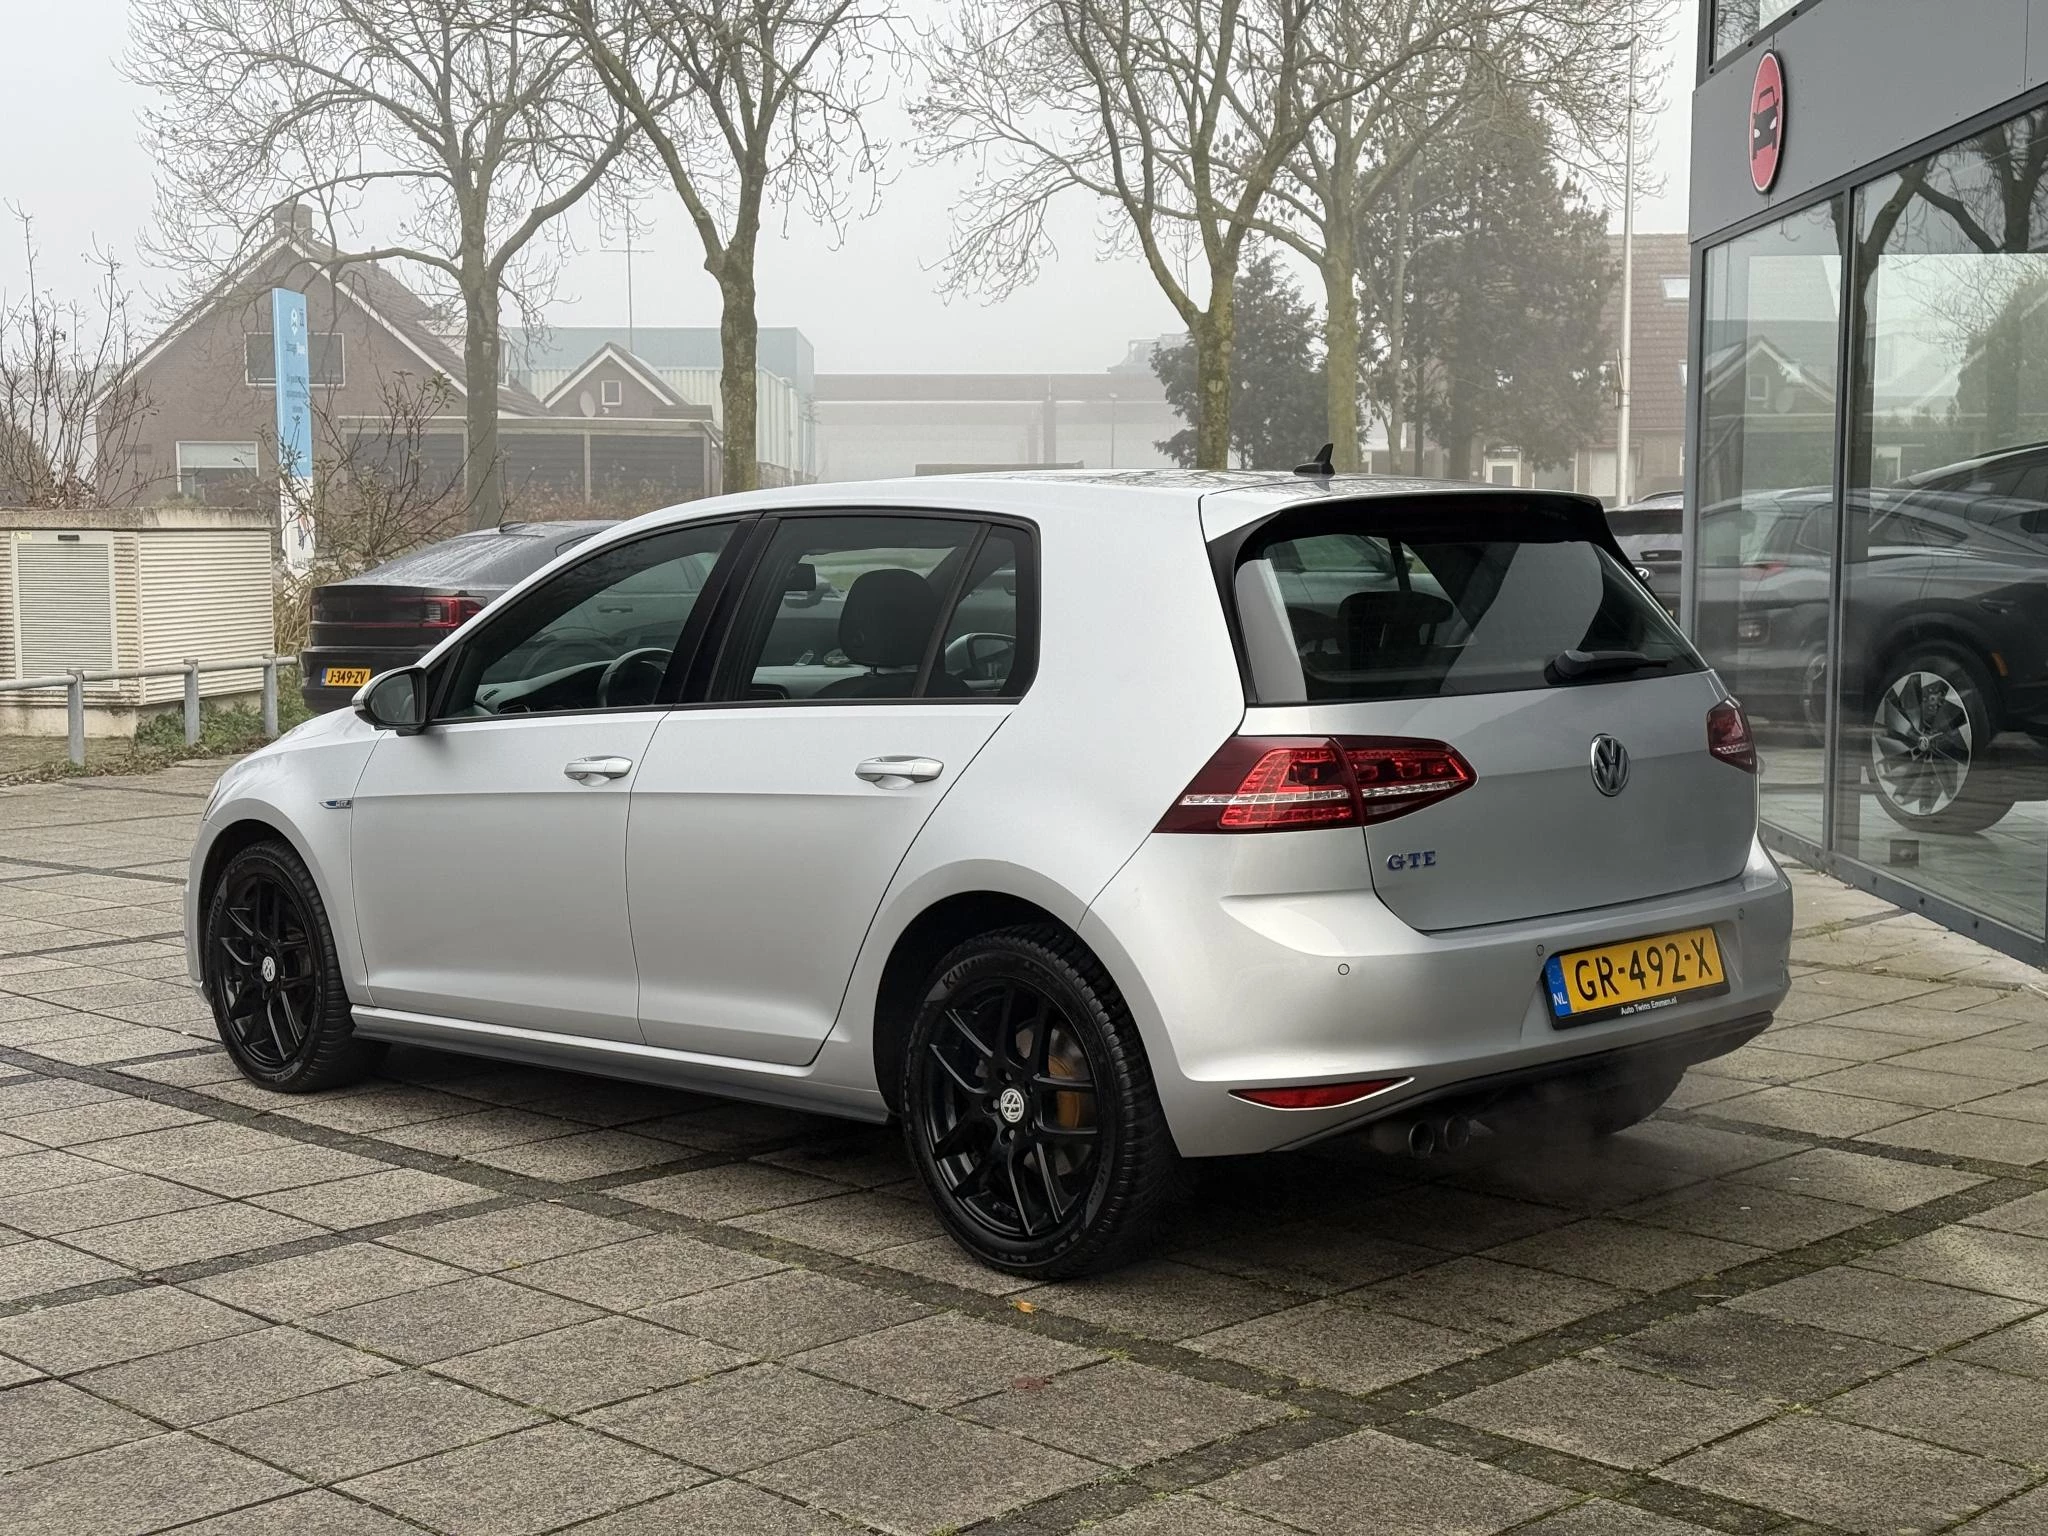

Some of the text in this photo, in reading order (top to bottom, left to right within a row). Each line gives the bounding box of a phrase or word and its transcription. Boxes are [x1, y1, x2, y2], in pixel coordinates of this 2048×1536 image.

[1387, 850, 1437, 871] GTE
[1574, 936, 1713, 1001] GR-492-X
[1553, 991, 1568, 1006] NL
[1621, 996, 1678, 1015] Auto Twins Emmen.nl
